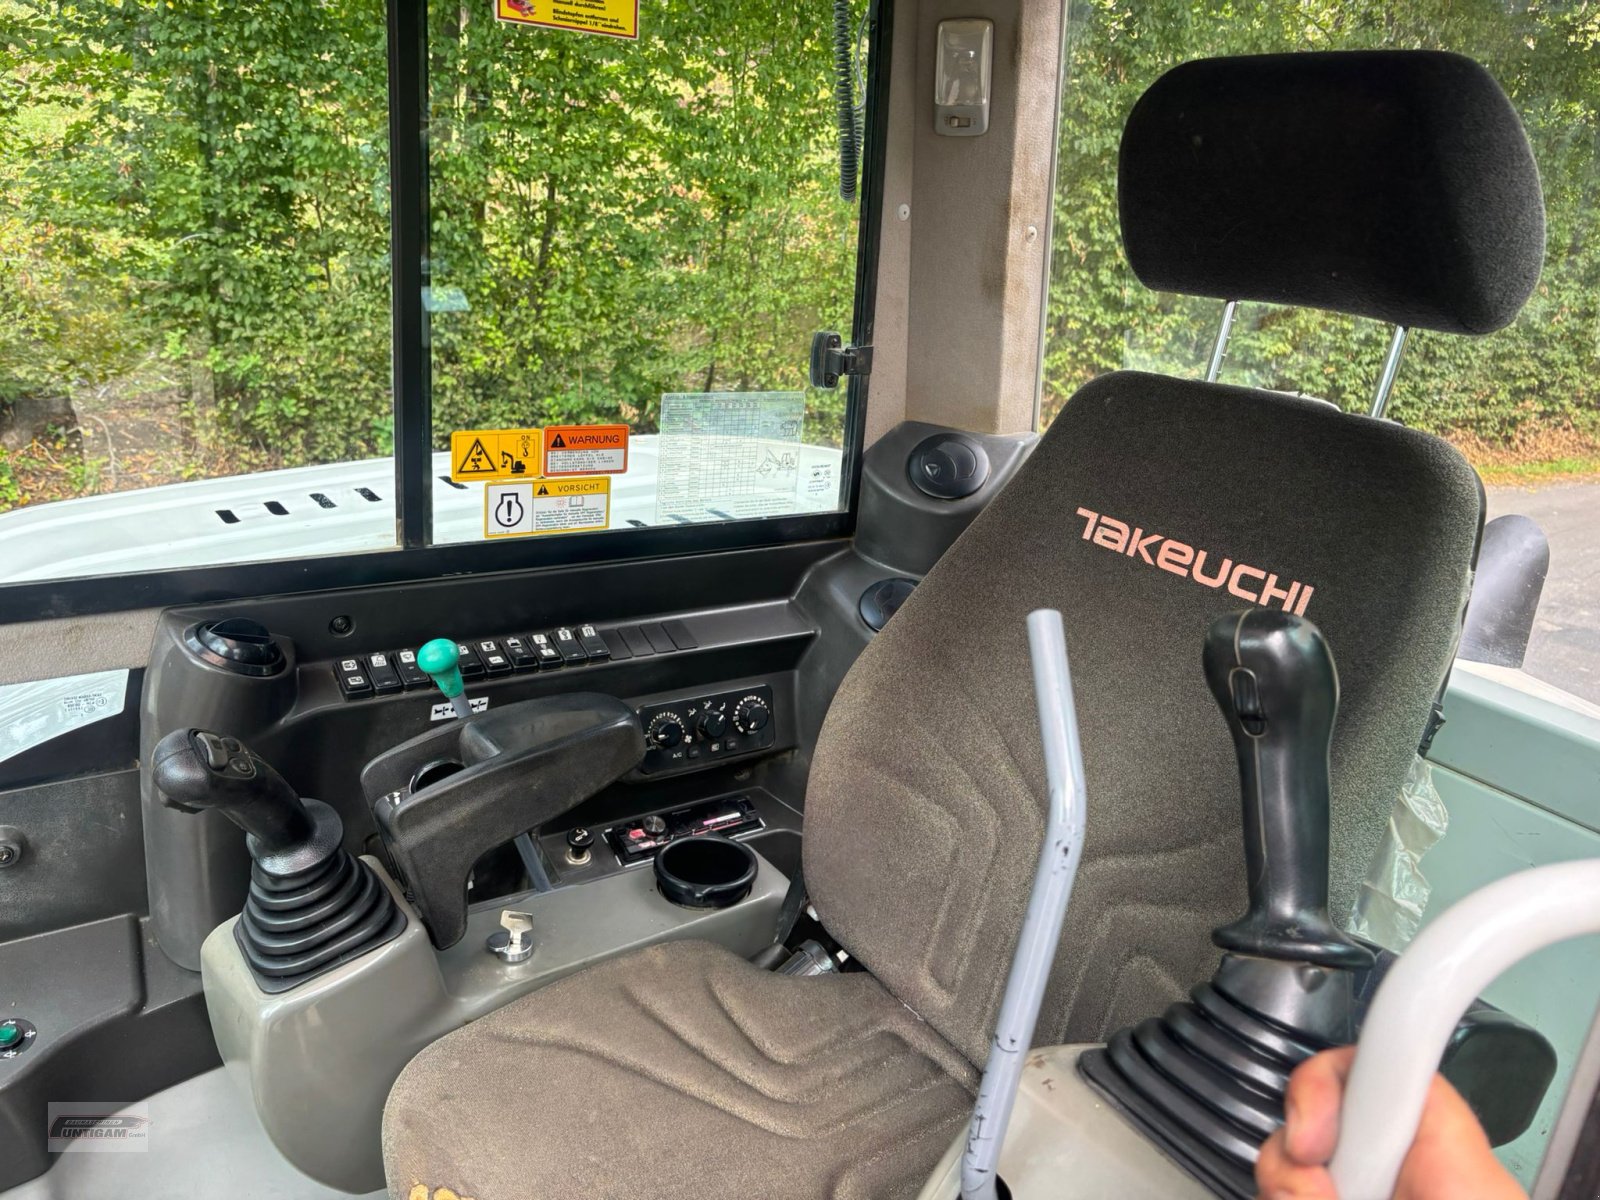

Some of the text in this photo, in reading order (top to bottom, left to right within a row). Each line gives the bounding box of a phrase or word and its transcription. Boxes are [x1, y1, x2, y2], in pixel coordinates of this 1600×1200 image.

[568, 434, 620, 445] WARNUNG
[557, 483, 600, 492] VORSICHT
[672, 751, 683, 759] A/C
